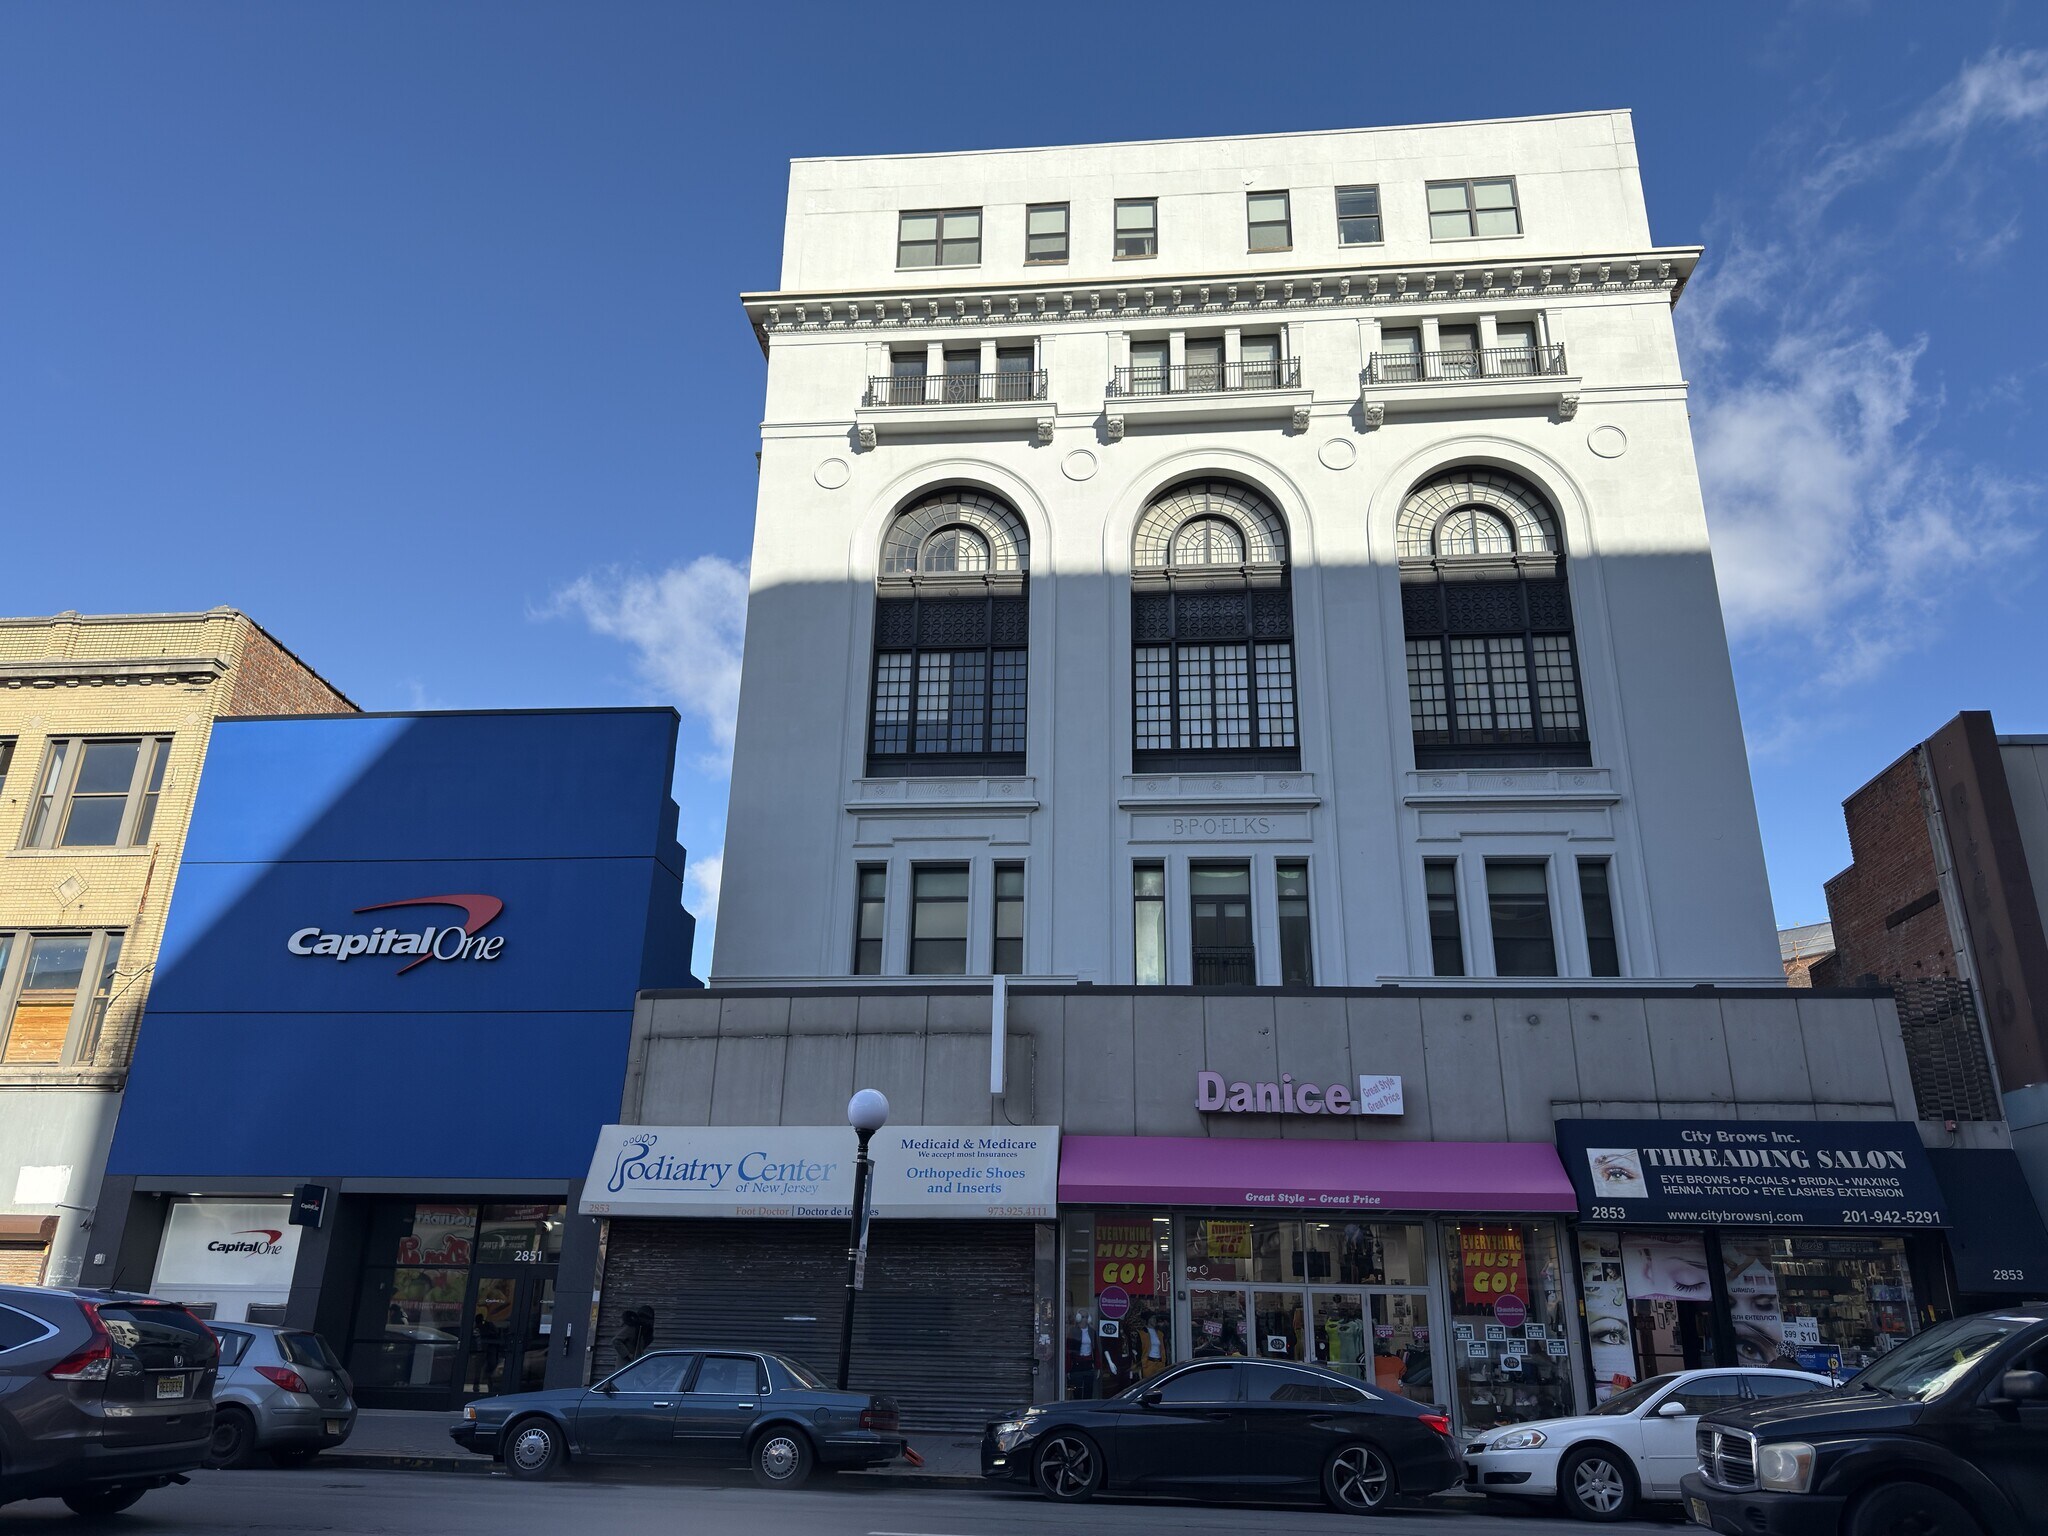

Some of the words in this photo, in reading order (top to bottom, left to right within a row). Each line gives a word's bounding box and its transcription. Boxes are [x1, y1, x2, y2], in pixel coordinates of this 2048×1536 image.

[1198, 1071, 1350, 1114] Danice
[1362, 1085, 1380, 1098] Great
[1380, 1076, 1396, 1090] Style
[1367, 1098, 1384, 1112] Great
[1384, 1092, 1400, 1106] Price
[900, 1138, 960, 1150] Medicaid
[963, 1139, 974, 1150] &
[978, 1138, 1037, 1150] Medicare
[1681, 1130, 1712, 1144] City
[1716, 1131, 1768, 1143] Brows
[1771, 1132, 1800, 1143] Inc.
[1642, 1148, 1811, 1169] THREADING
[1816, 1150, 1906, 1169] SALON
[608, 1143, 733, 1192] Podiatry
[738, 1151, 837, 1182] Center
[906, 1167, 982, 1182] Orthopedic
[986, 1167, 1026, 1179] Shoes
[1660, 1174, 1685, 1184] EYE
[1687, 1175, 1730, 1185] BROWS
[1740, 1176, 1790, 1186] FACIALS
[1799, 1176, 1844, 1186] BRIDAL
[1850, 1177, 1900, 1187] WAXING
[736, 1182, 748, 1192] of
[752, 1183, 780, 1193] New
[781, 1184, 819, 1196] Jersey
[927, 1182, 952, 1194] and
[956, 1182, 1002, 1194] Inserts
[1663, 1186, 1704, 1195] HENNA
[1706, 1186, 1750, 1196] TATTOO
[1762, 1186, 1786, 1196] EYE
[1788, 1187, 1835, 1197] LASHES
[1838, 1188, 1904, 1198] EXTENSION
[1246, 1192, 1275, 1202] Great
[1278, 1193, 1305, 1204] Style
[1320, 1194, 1350, 1203] Great
[1352, 1195, 1381, 1204] Price
[588, 1204, 610, 1213] 2853
[736, 1206, 756, 1216] Foot
[758, 1206, 790, 1216] Doctor
[798, 1207, 828, 1216] Doctor
[830, 1207, 842, 1216] de
[988, 1207, 1047, 1216] 973.925.4111
[1591, 1206, 1626, 1220] 2853
[1668, 1210, 1804, 1224] www.citybrowsnj.com
[1842, 1210, 1942, 1224] 201-942-5291
[1096, 1226, 1150, 1242] EVERYTHING
[1462, 1234, 1522, 1250] EVERYTHING
[514, 1250, 542, 1262] 2851
[1096, 1244, 1150, 1258] MUST
[1466, 1252, 1522, 1268] MUST
[1102, 1262, 1146, 1284] GO!
[1992, 1269, 2024, 1281] 2853
[1473, 1271, 1518, 1293] GO!
[1784, 1330, 1797, 1338] $99
[1800, 1332, 1818, 1342] $10
